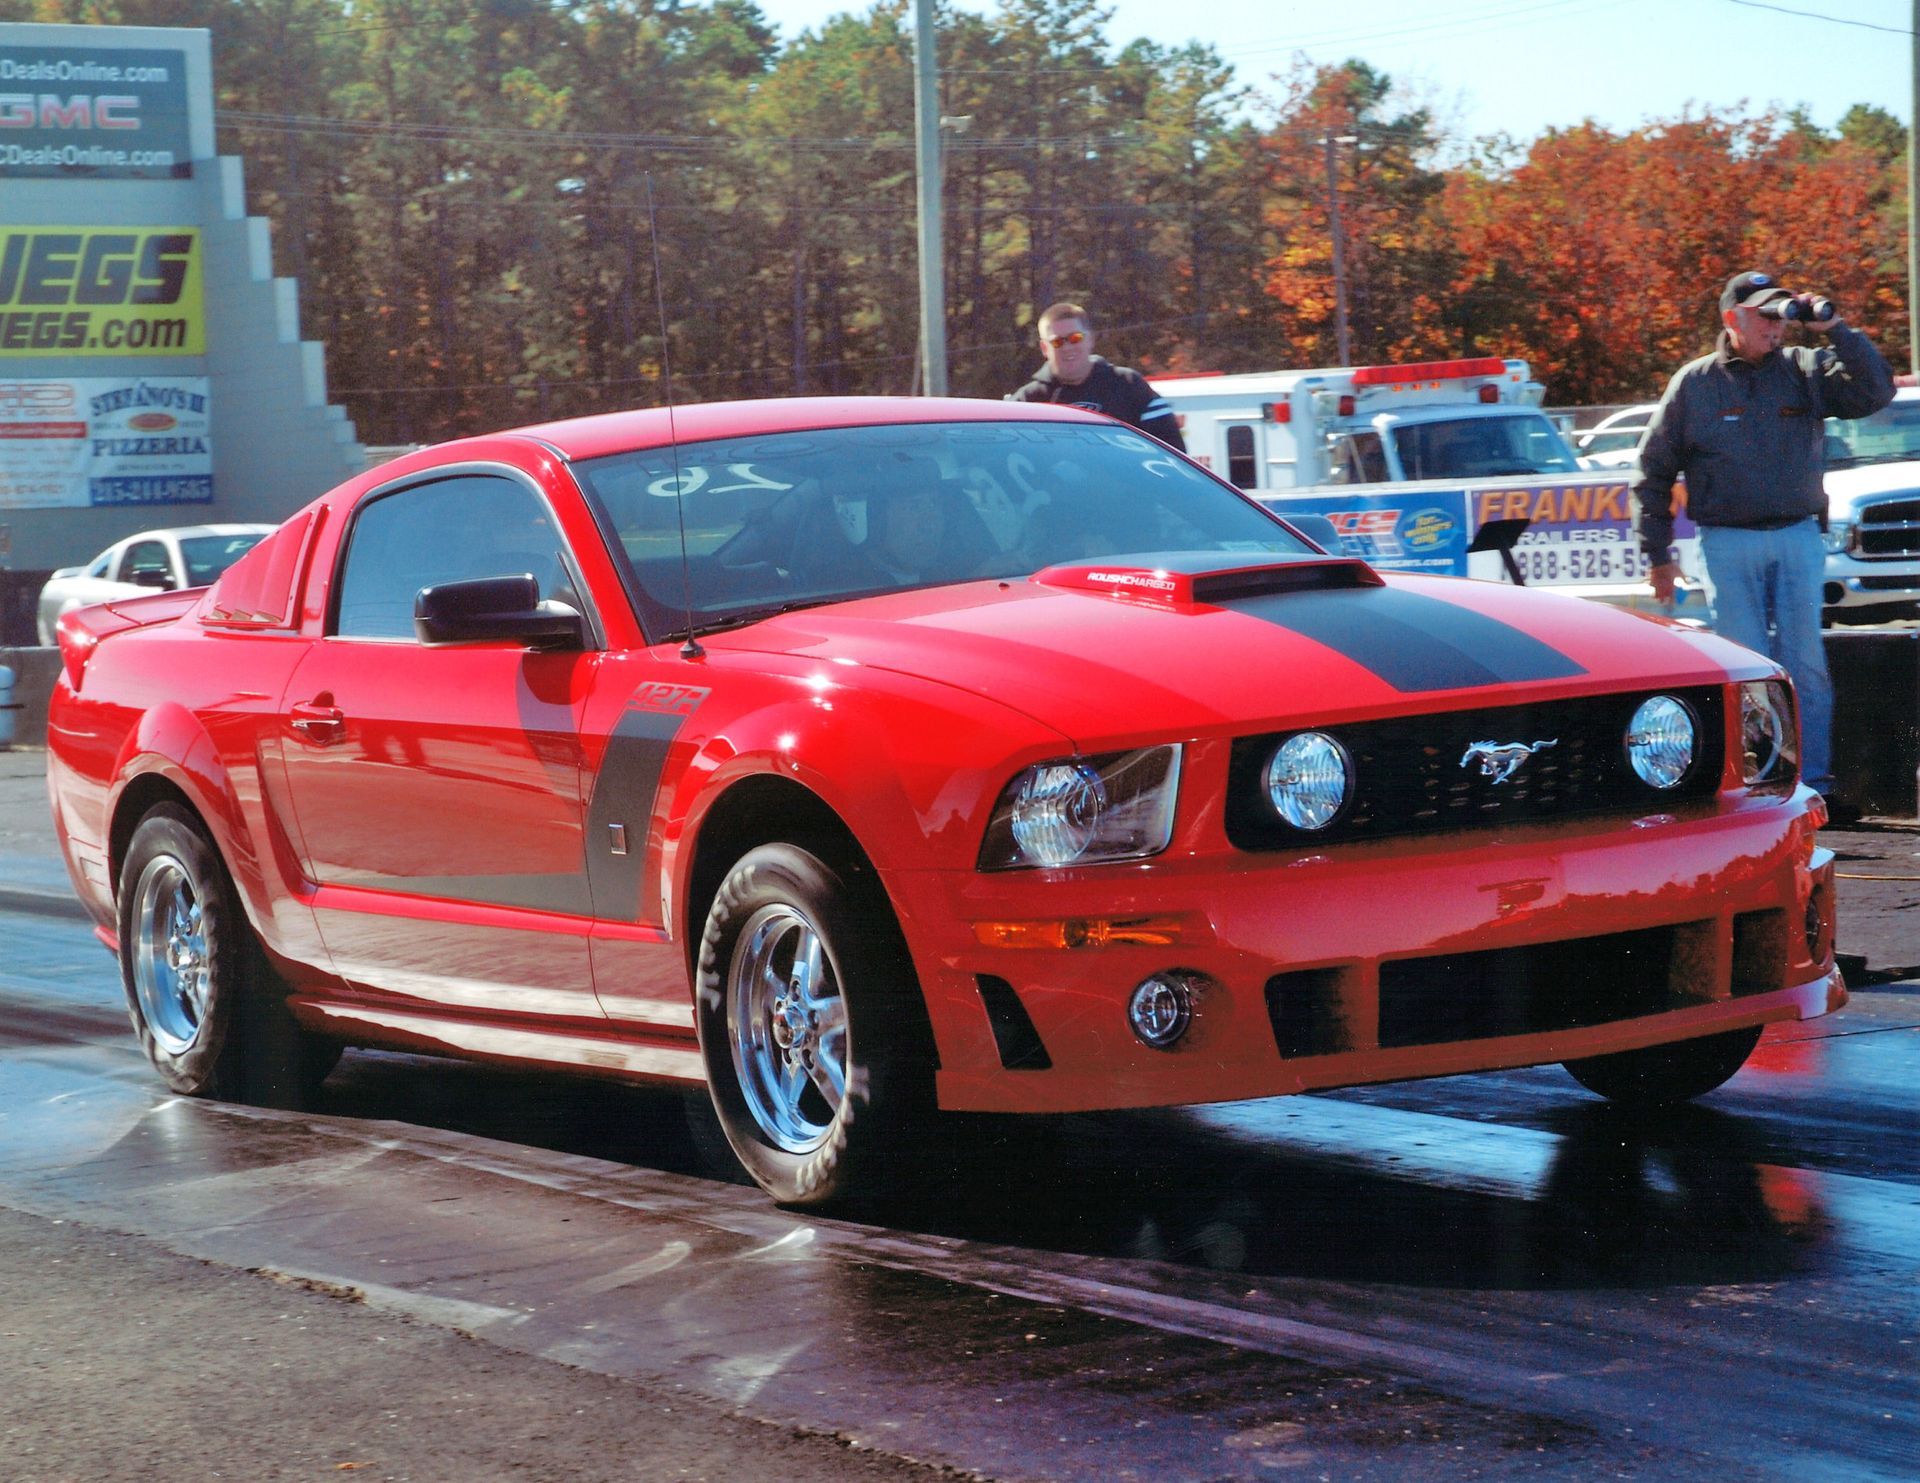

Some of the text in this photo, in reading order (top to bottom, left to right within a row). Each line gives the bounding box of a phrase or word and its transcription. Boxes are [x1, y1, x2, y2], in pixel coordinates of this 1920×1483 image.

[0, 93, 141, 129] GMC
[0, 312, 187, 349] EGS.com
[93, 436, 208, 457] PIZZERIA
[1516, 528, 1619, 546] RAILERS
